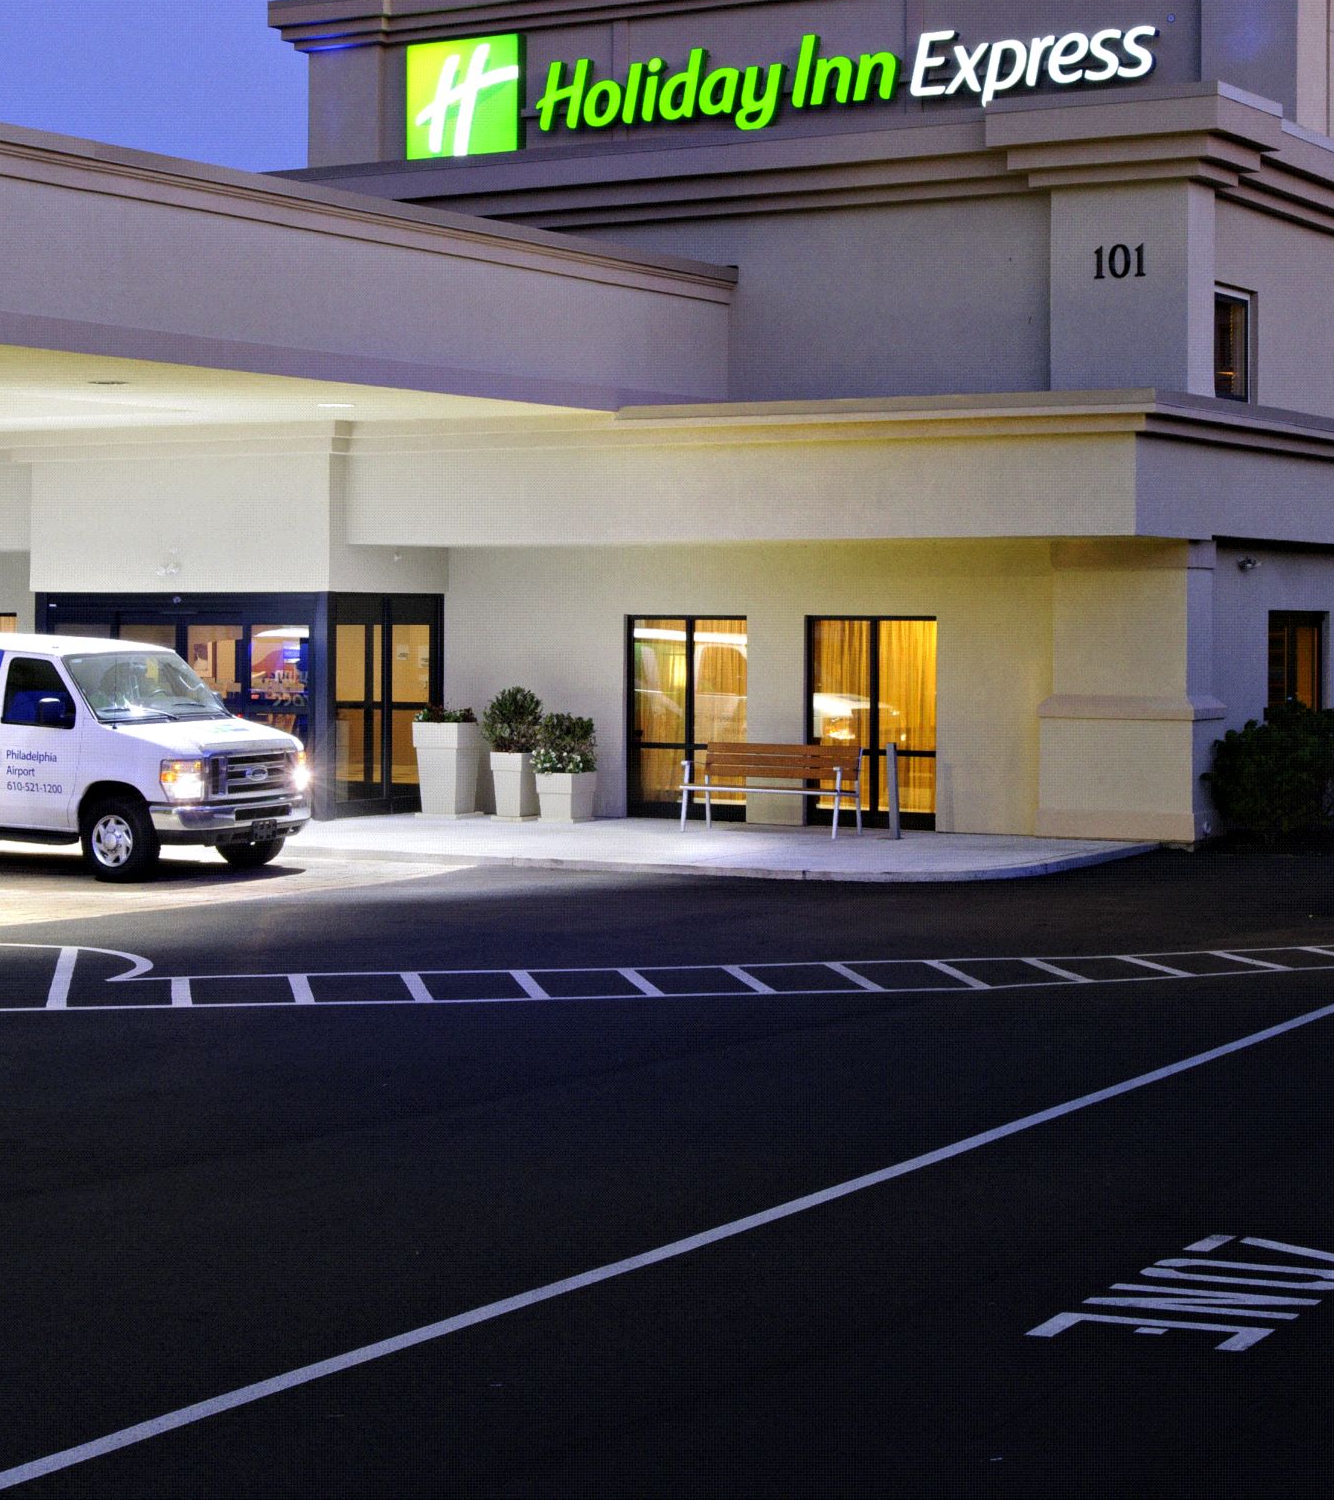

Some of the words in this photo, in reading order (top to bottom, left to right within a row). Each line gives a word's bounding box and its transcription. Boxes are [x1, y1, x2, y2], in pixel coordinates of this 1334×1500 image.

[536, 47, 788, 131] Holiday
[791, 34, 896, 108] Inn
[909, 25, 1157, 108] Express
[1093, 242, 1146, 279] 101
[6, 749, 58, 764] Philadelphia
[6, 765, 35, 778] Airport
[6, 781, 63, 794] 610-521-1200
